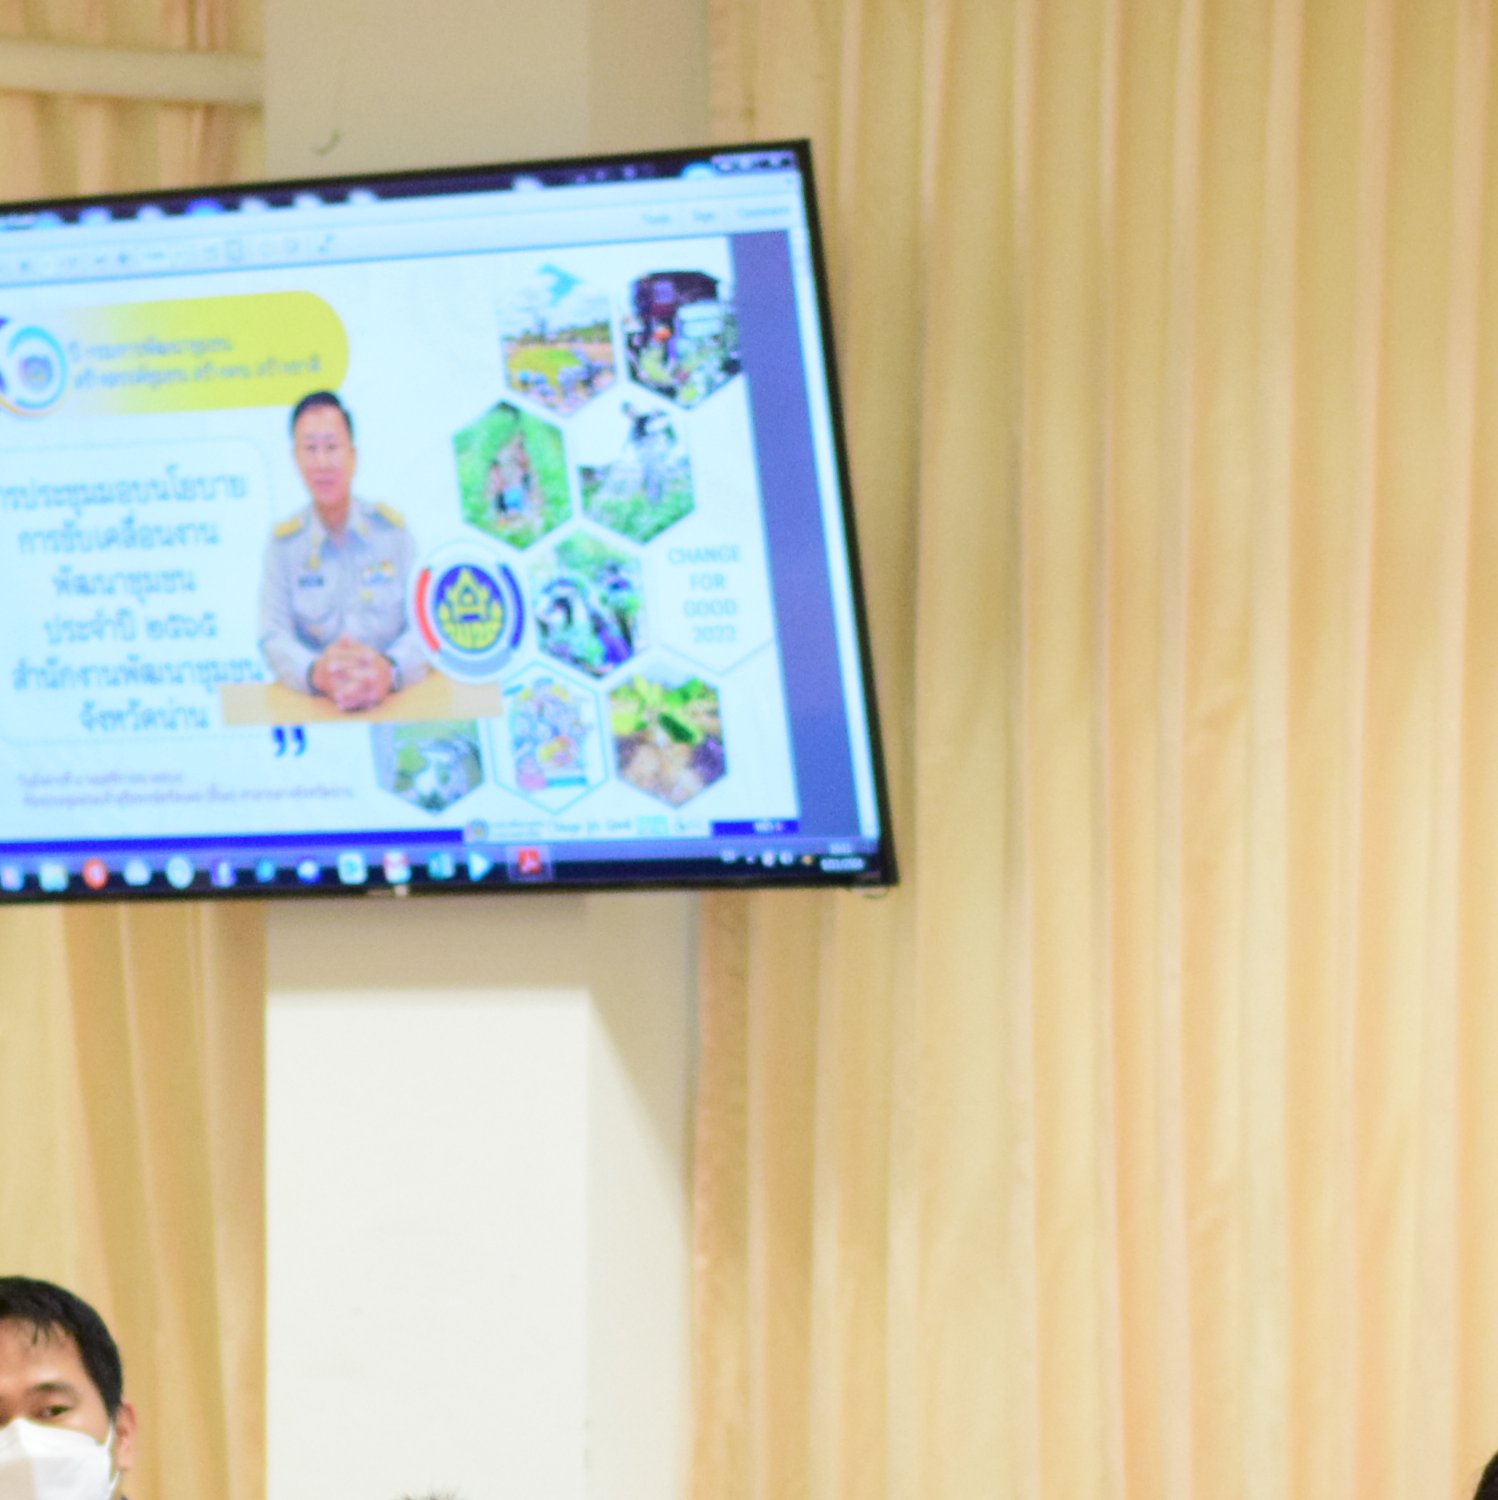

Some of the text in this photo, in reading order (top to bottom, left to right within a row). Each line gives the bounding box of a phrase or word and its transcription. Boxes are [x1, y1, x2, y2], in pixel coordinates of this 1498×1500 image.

[18, 510, 220, 553] การขับเคลื่อนงาน
[668, 545, 740, 565] CHANGE
[51, 565, 197, 604] พัฒนาชุมชน
[689, 573, 726, 591] FOR
[683, 598, 737, 618] GOOD
[43, 608, 218, 645] ประจำปี ๒๕๖๕
[692, 625, 736, 644] 2022
[13, 653, 264, 694] สำนักงานพัฒนาชุมชน
[79, 698, 209, 732] จังหวัดน่าน
